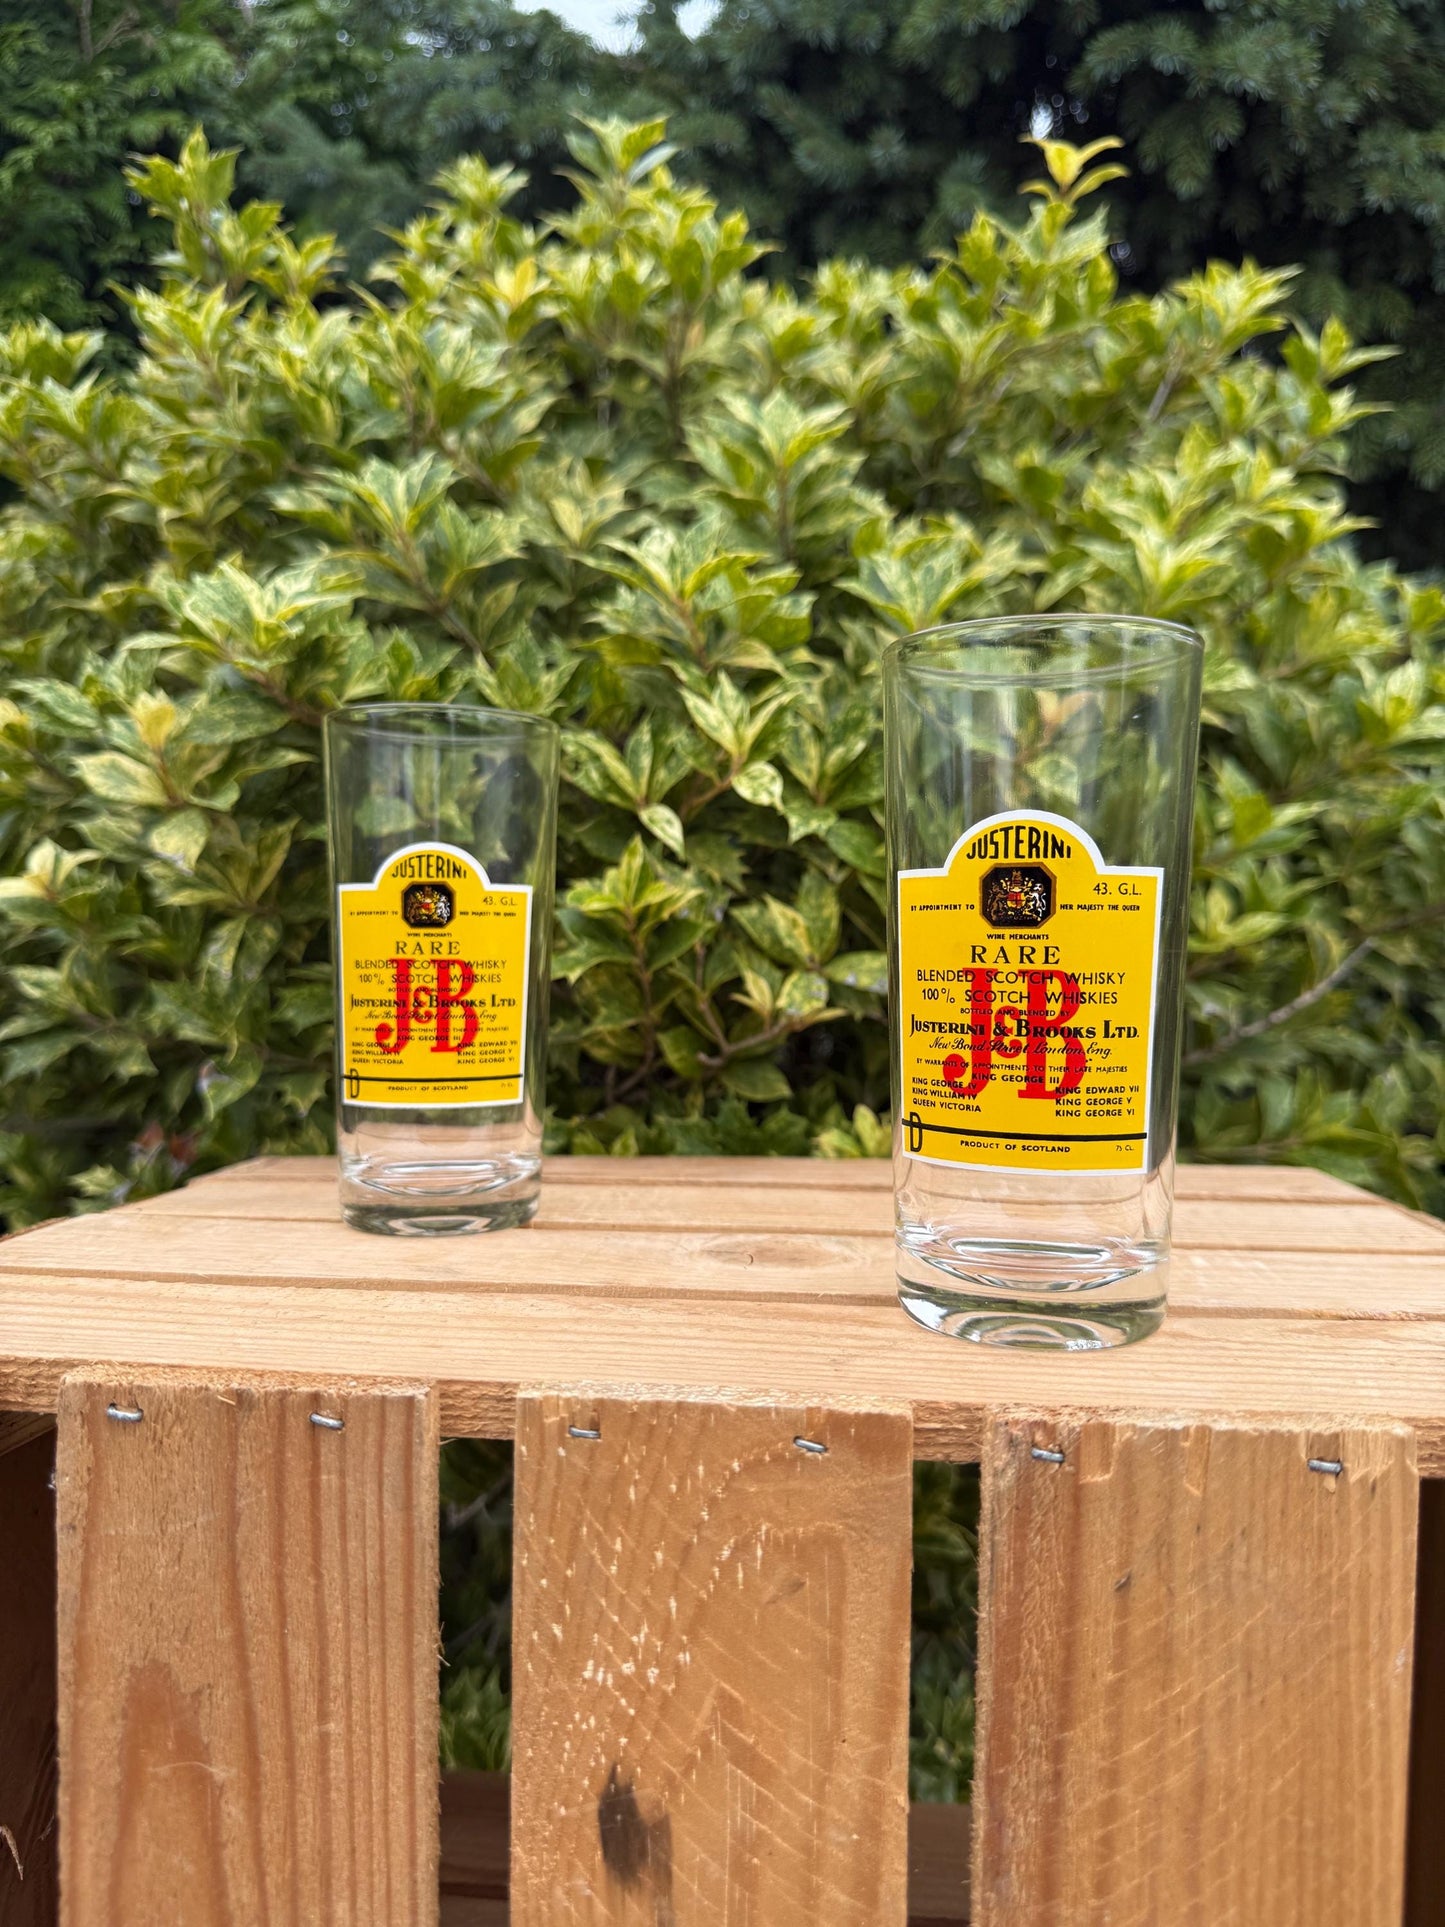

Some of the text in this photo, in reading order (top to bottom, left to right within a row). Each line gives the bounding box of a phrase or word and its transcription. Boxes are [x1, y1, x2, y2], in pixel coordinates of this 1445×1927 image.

[966, 825, 1072, 860] JUSTERINI
[392, 854, 467, 879] JUSTERINI
[1093, 882, 1113, 896] 43.
[1077, 904, 1104, 912] MAJESTY
[396, 941, 461, 955] RARE
[971, 945, 1060, 964] RARE
[355, 960, 507, 970] BLENDED SCOTCH WHISKY
[391, 974, 439, 984] SCOTCH
[449, 974, 502, 984] WHISKIES
[917, 969, 1126, 985] BLENDED SCOTCH WHISKY
[965, 989, 1031, 1003] SCOTCH
[1045, 992, 1118, 1004] WHISKIES
[993, 1022, 1010, 1037] &
[929, 1036, 951, 1049] New
[952, 1037, 985, 1051] Bond
[925, 1059, 957, 1067] WARRANTS
[973, 1063, 1029, 1071] APPOINTMENTS
[1096, 1066, 1128, 1074] MAJESTIES
[912, 1077, 928, 1085] KING
[931, 1079, 963, 1089] GEORGE
[971, 1073, 1060, 1084] KING GEORGE III
[912, 1087, 928, 1095] KING
[930, 1089, 965, 1100] WILLIAM
[1055, 1086, 1081, 1094] KING
[1086, 1086, 1126, 1094] EDWARD
[912, 1098, 981, 1112] QUEEN VICTORIA
[1055, 1098, 1081, 1106] KING
[1055, 1108, 1135, 1117] KING GEORGE VI
[960, 1140, 1000, 1149] PRODUCT
[1021, 1144, 1070, 1153] SCOTLAND
